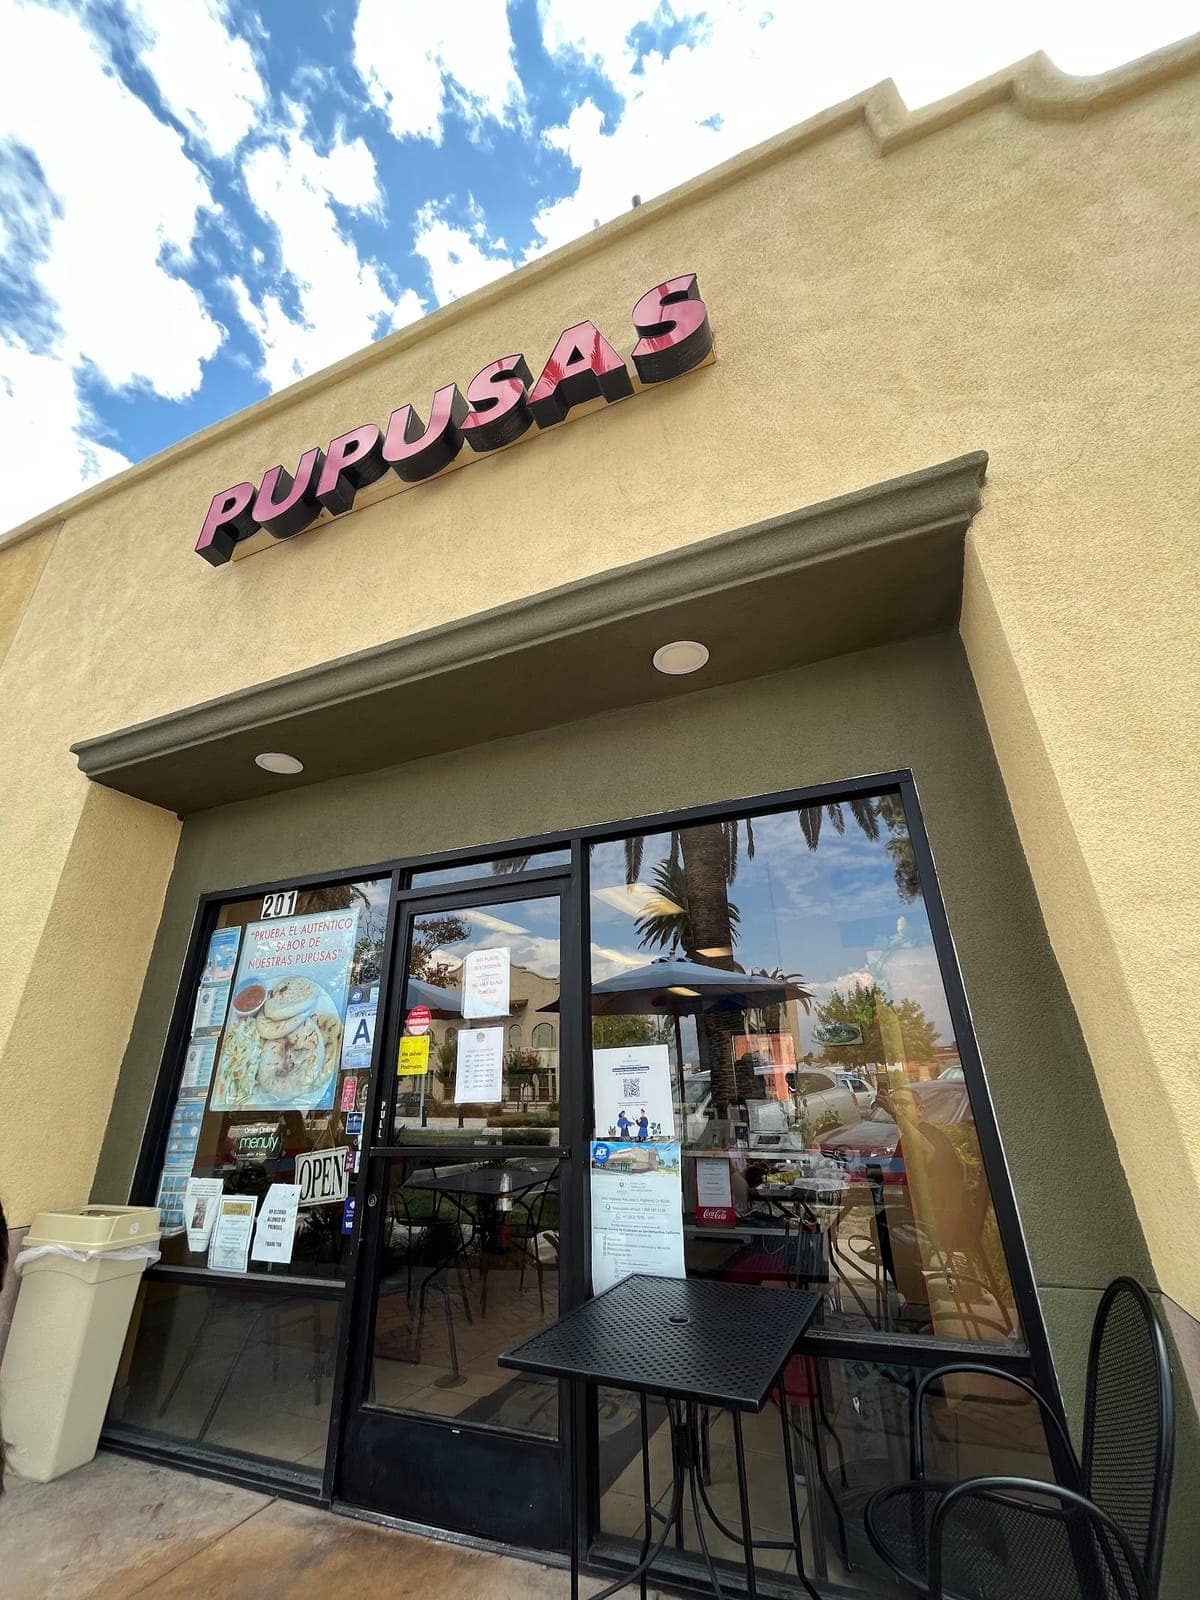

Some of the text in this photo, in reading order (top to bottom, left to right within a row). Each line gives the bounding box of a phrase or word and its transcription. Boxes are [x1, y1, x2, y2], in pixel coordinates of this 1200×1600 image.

[194, 272, 713, 566] PUPUSAS
[263, 892, 296, 918] 201
[289, 926, 297, 936] EL
[276, 937, 321, 952] SABOR DE
[248, 955, 293, 969] NUESTRAS
[352, 1019, 370, 1044] A
[260, 1126, 276, 1134] Online
[378, 1101, 386, 1138] PULL
[239, 1133, 278, 1152] menufy
[300, 1154, 345, 1201] OPEN
